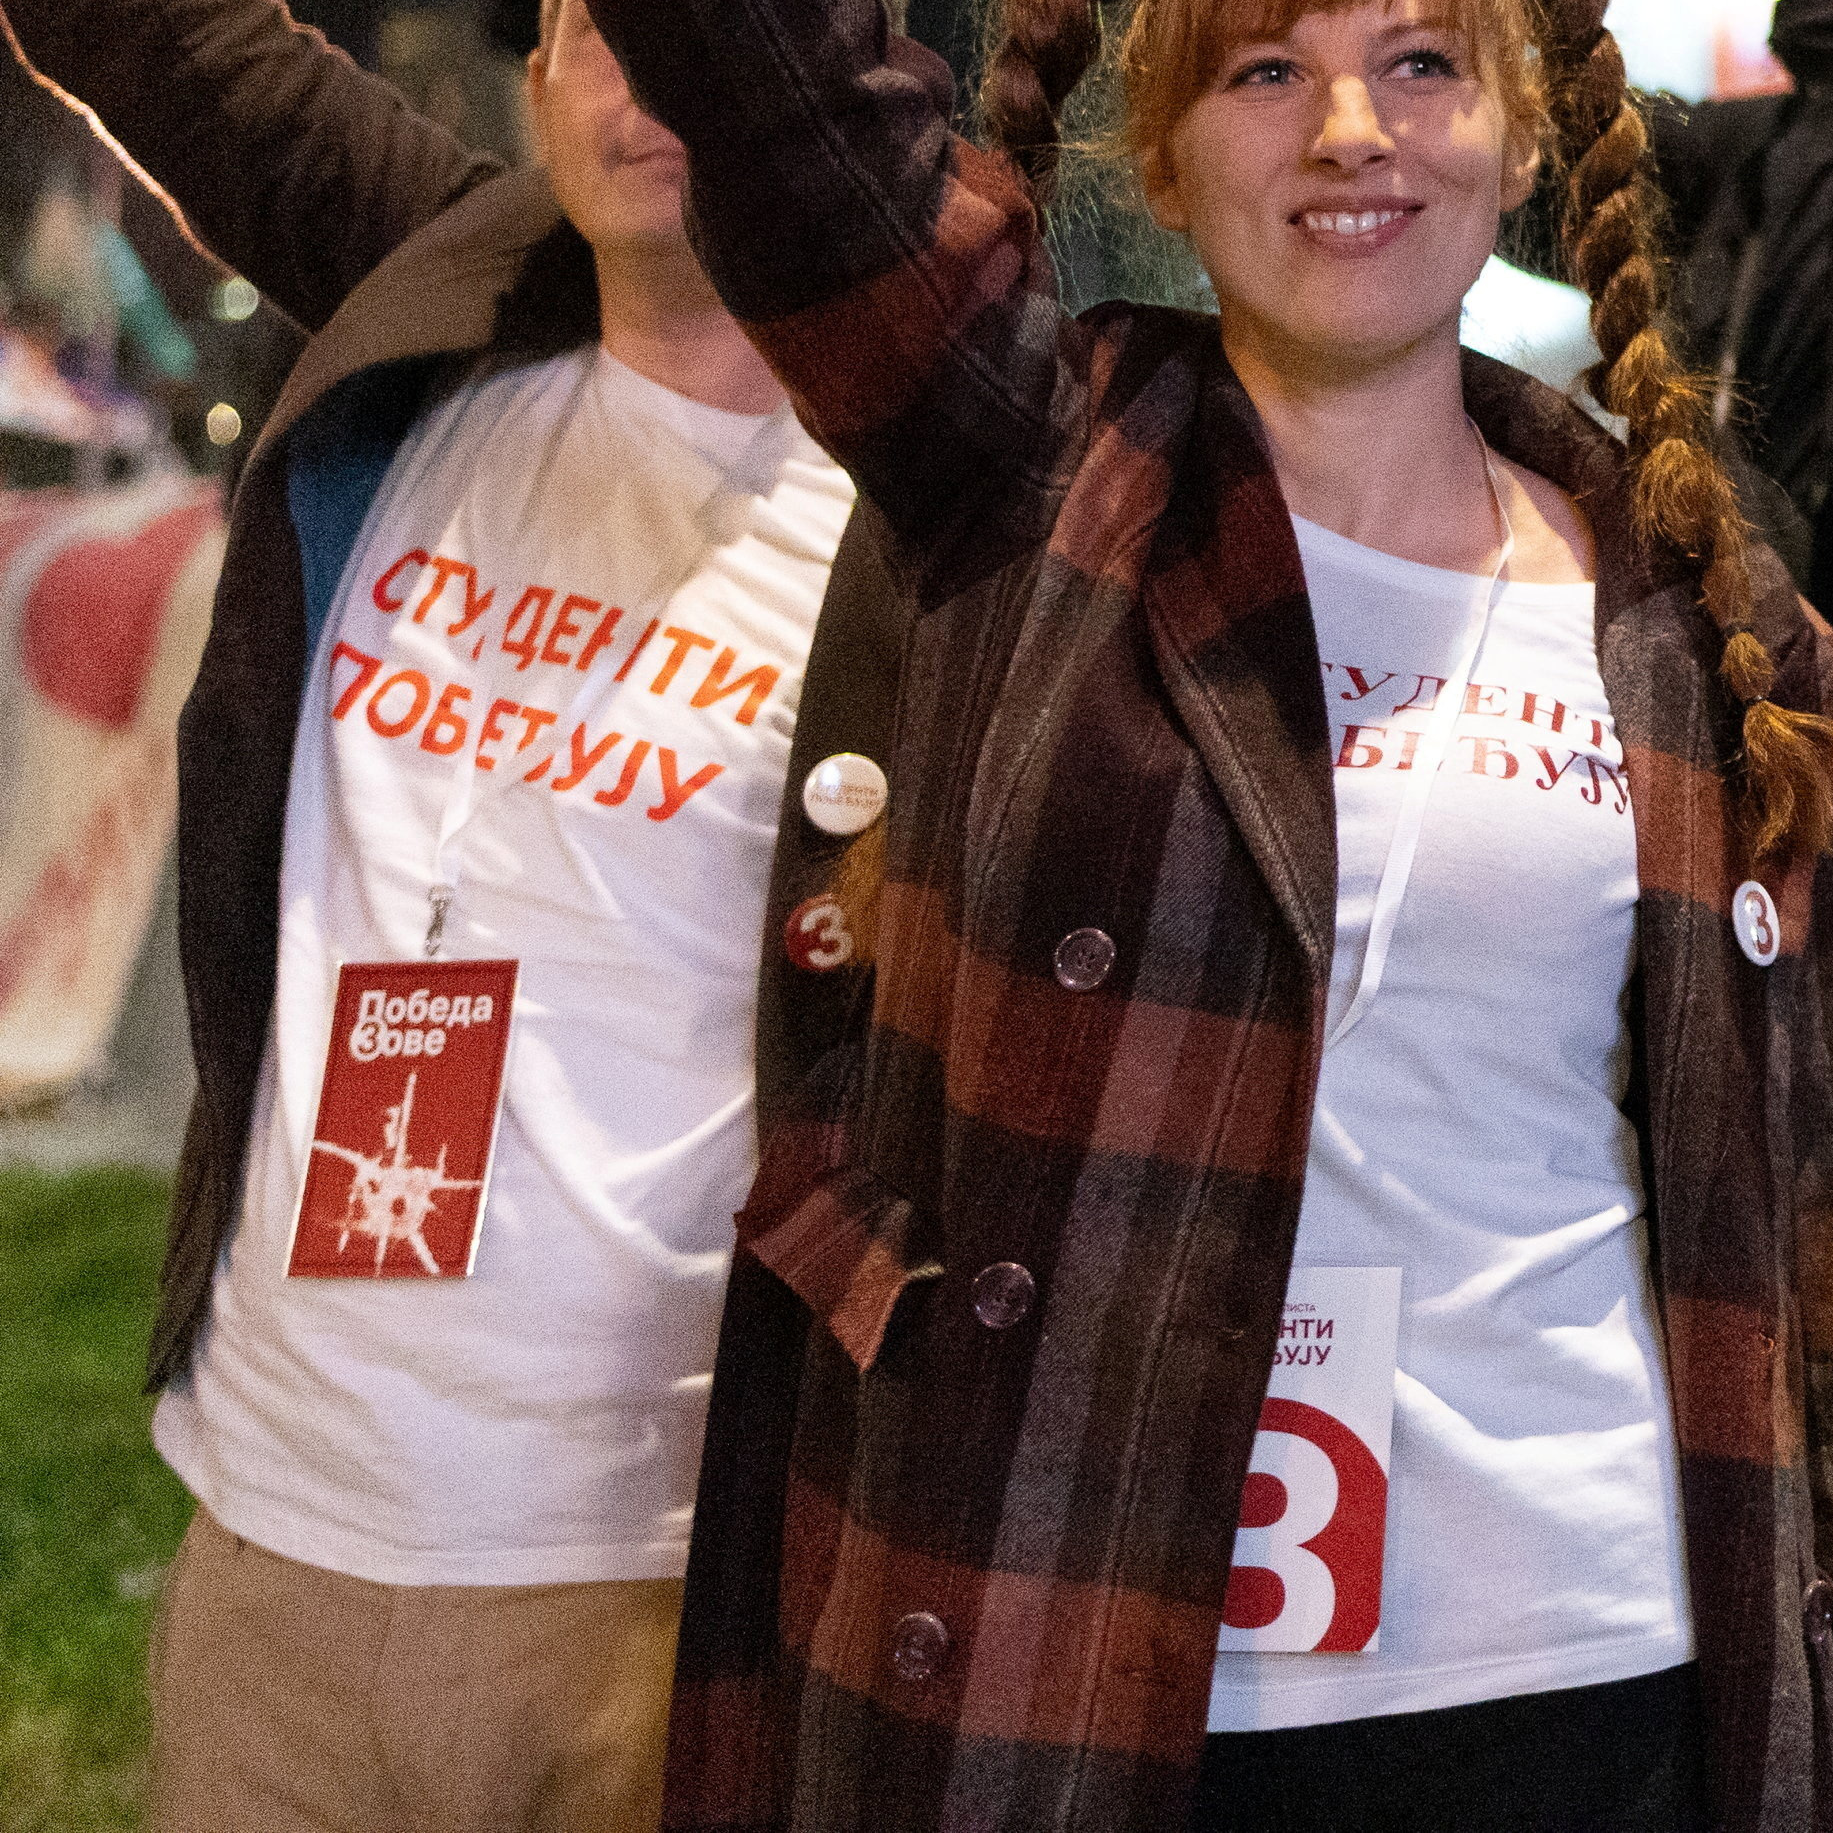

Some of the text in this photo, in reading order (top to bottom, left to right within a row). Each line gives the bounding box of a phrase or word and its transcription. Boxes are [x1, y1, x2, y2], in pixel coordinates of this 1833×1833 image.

[372, 548, 782, 726] СТУДЕНТИ
[801, 903, 853, 968] 3
[1745, 890, 1774, 956] 3
[359, 988, 494, 1028] Победа
[1217, 1429, 1340, 1652] 3
